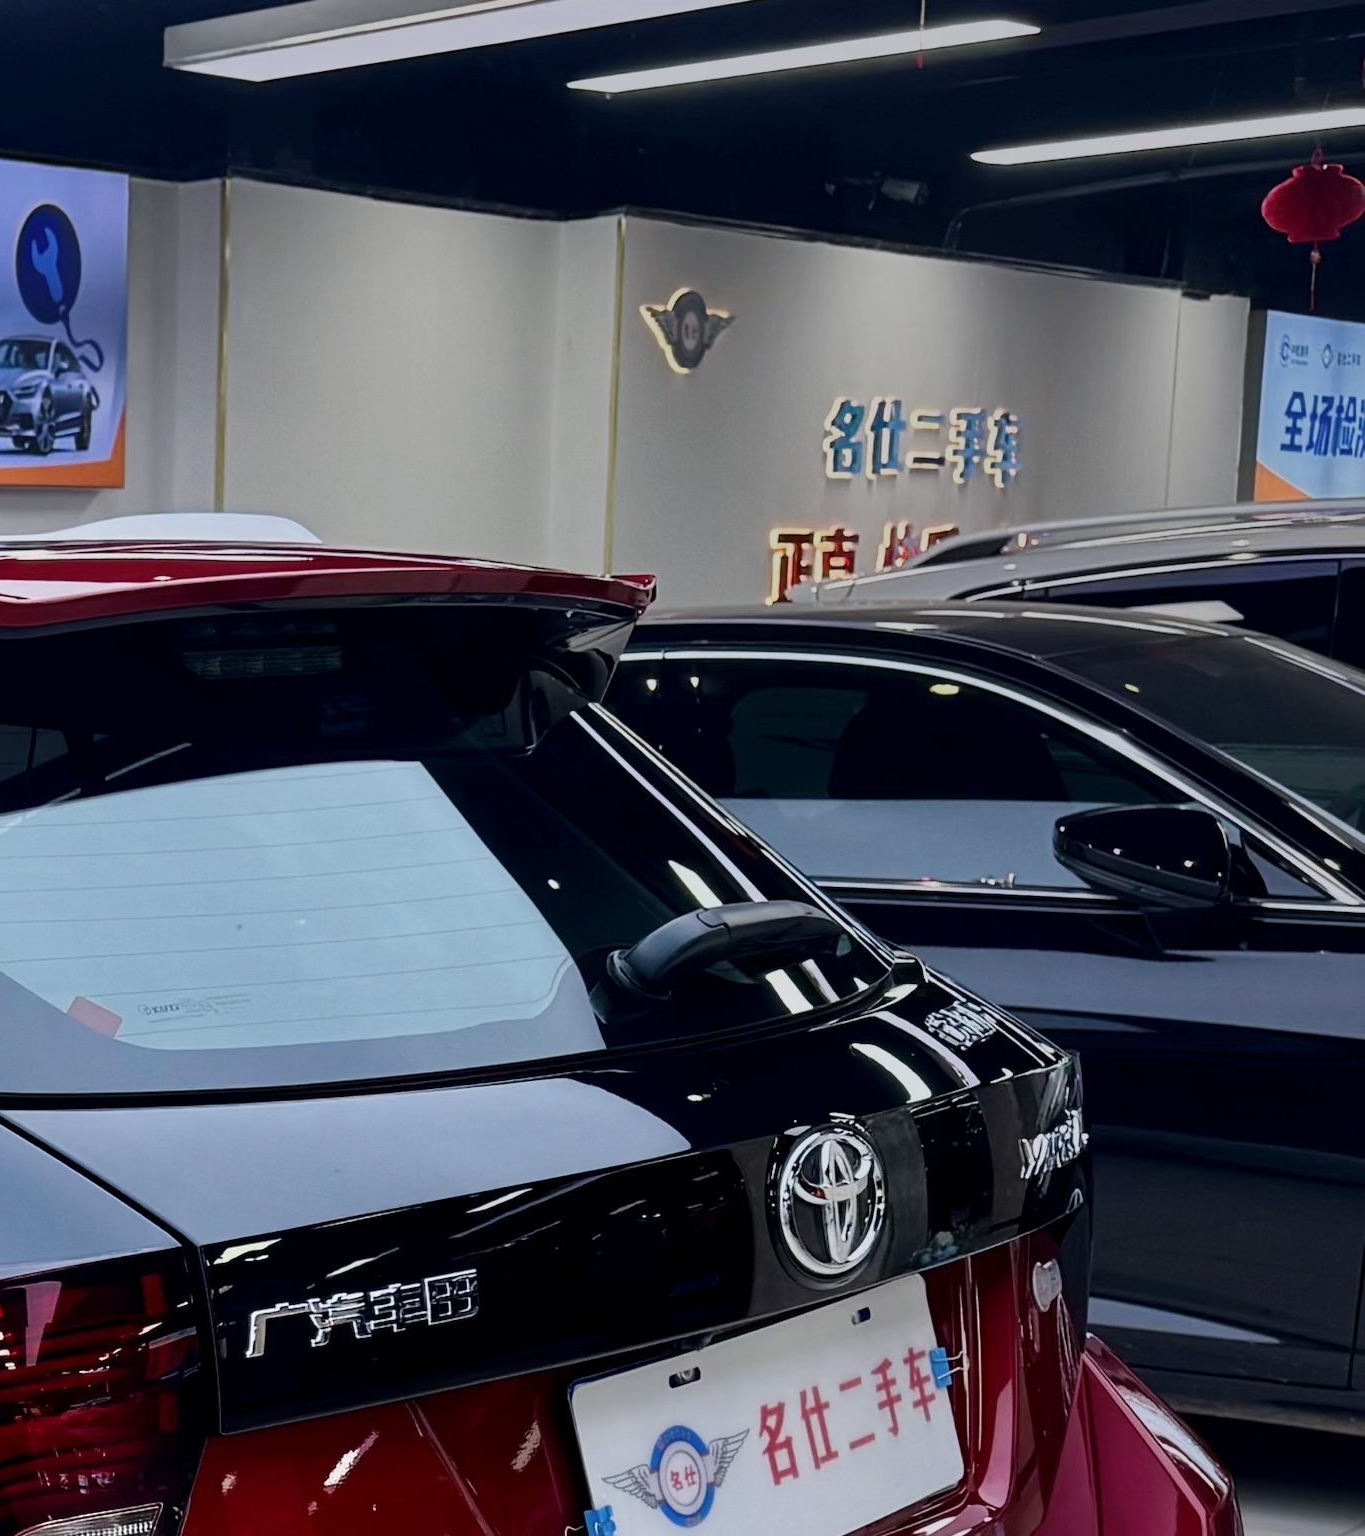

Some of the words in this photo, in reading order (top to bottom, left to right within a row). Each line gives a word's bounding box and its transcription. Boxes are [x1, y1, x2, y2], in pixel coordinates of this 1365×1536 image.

[823, 396, 1023, 489] 名仕二手车
[758, 1346, 936, 1486] 名仕二手车
[670, 1464, 697, 1492] 名仕
